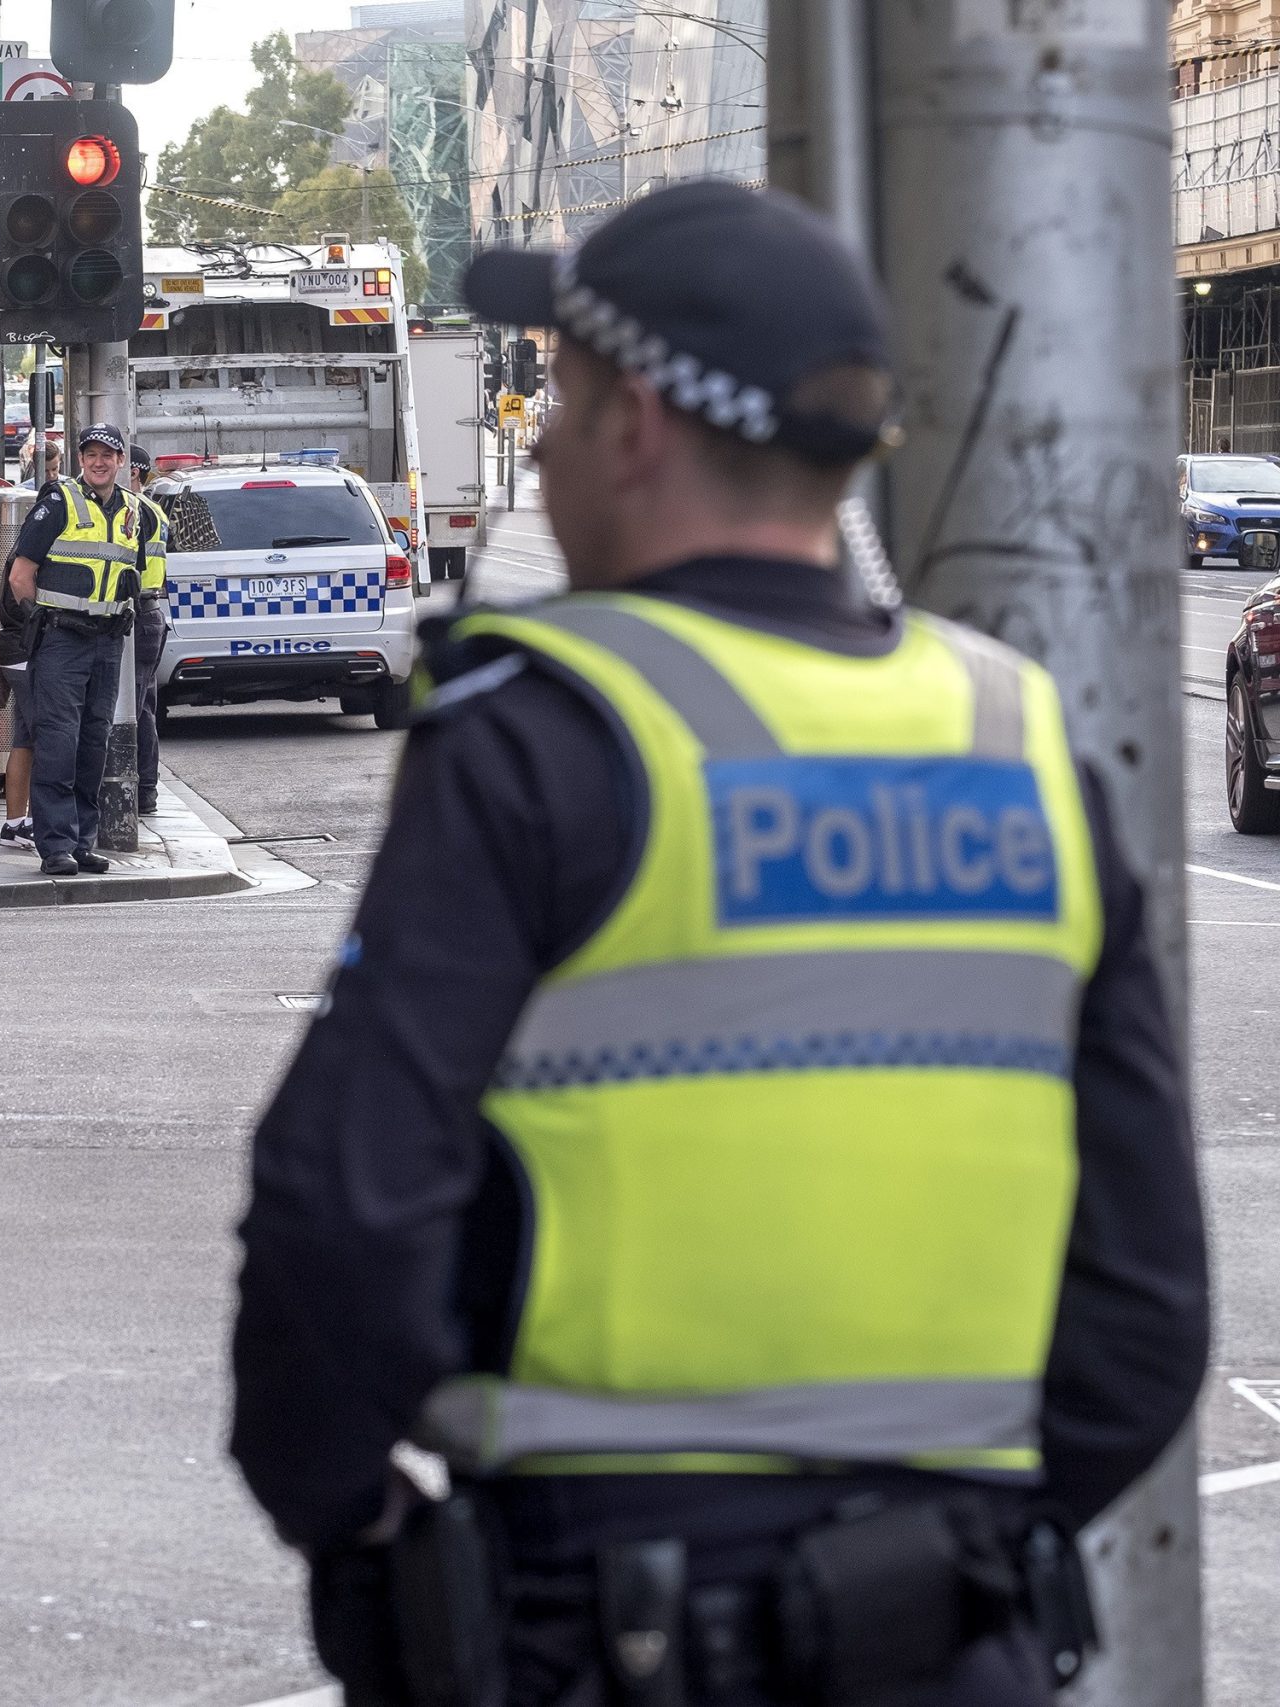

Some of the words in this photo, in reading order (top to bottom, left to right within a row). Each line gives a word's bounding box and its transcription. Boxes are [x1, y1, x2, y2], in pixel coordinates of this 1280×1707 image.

[301, 274, 321, 286] YNU
[328, 274, 348, 286] 004
[282, 579, 305, 593] 3FS
[230, 638, 332, 656] Police
[728, 780, 1055, 900] Police
